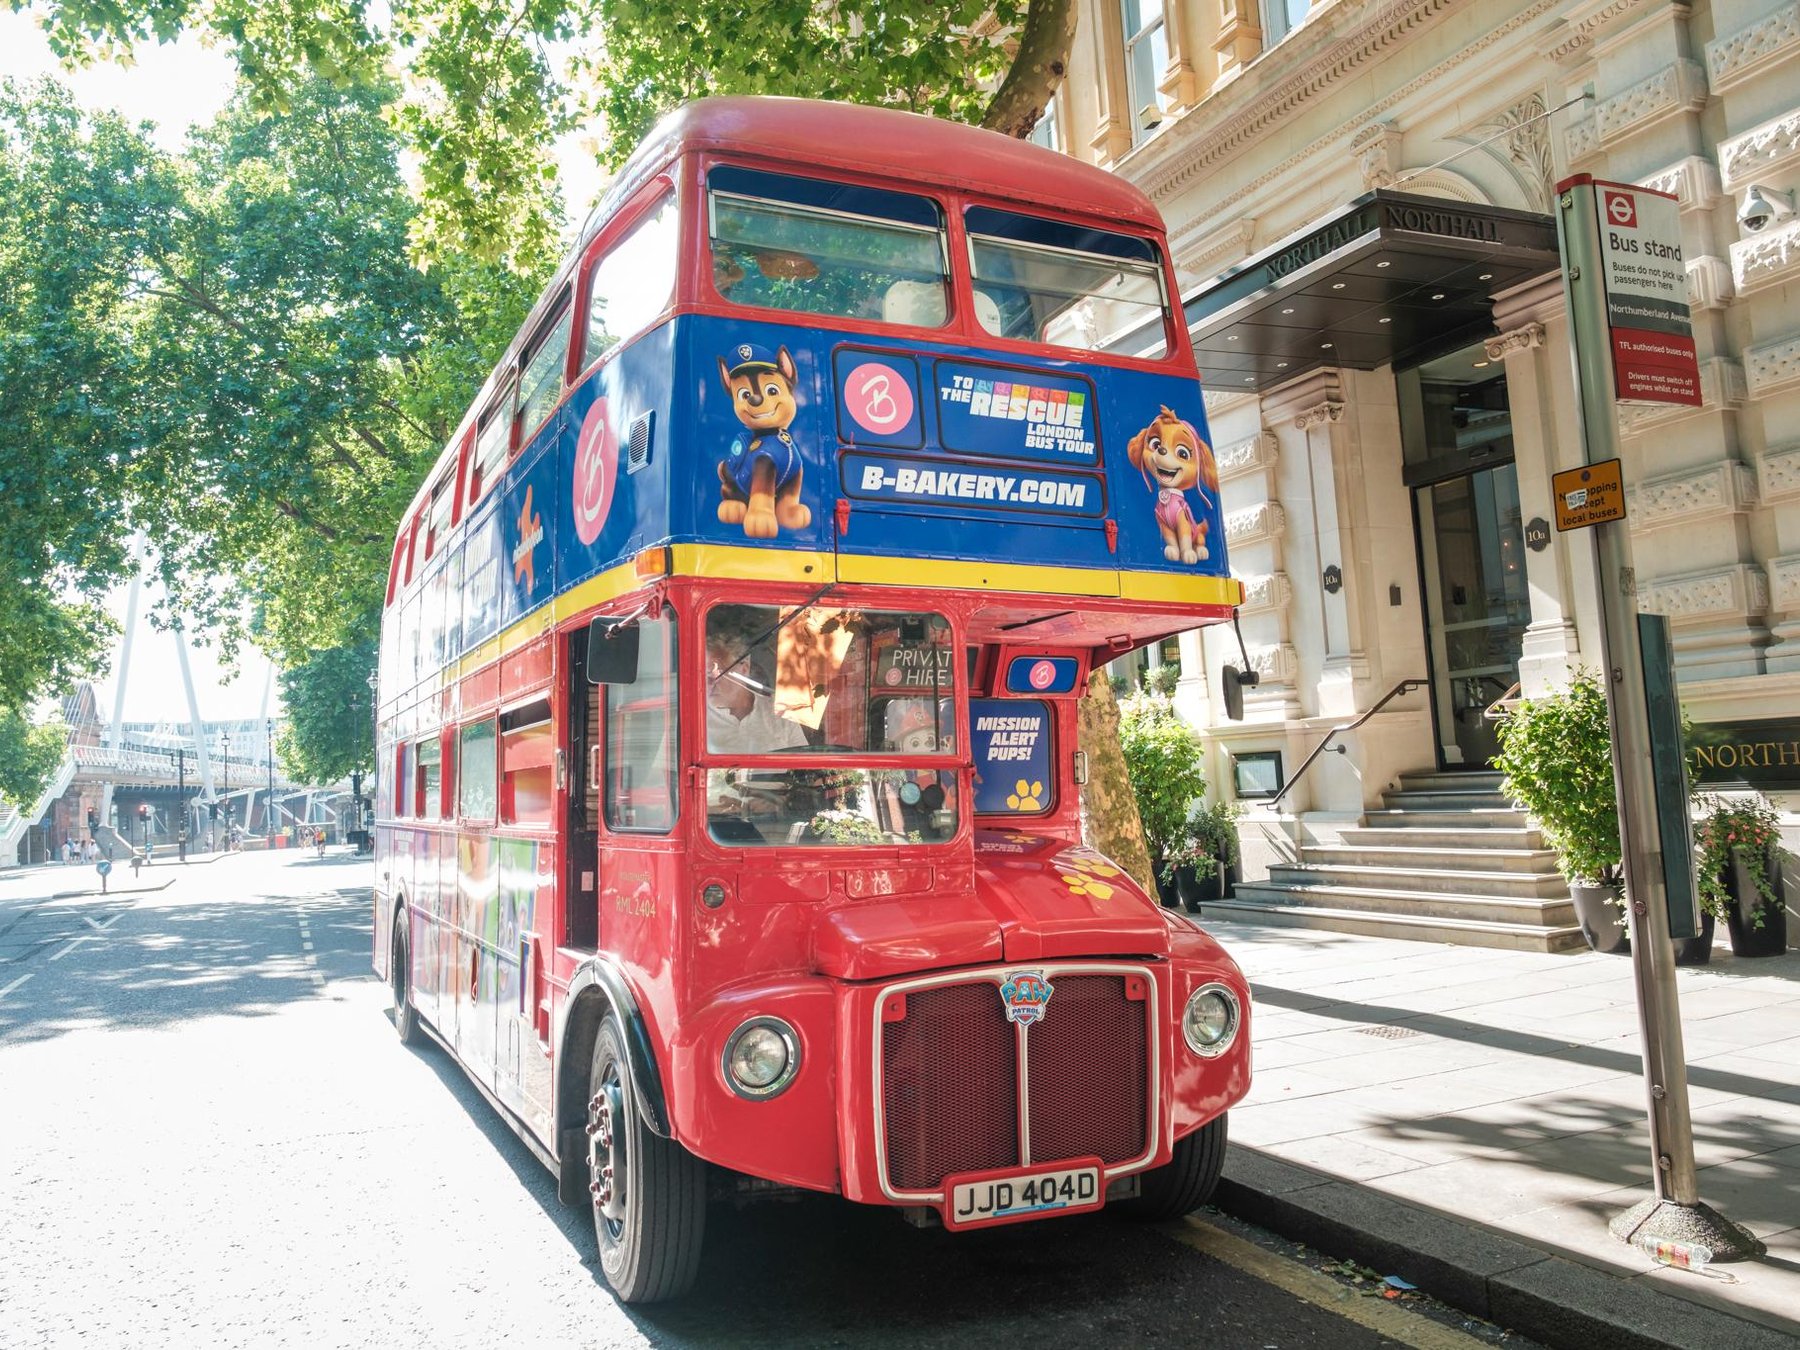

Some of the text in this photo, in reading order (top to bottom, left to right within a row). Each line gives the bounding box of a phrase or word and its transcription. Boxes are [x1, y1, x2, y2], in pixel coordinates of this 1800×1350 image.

[1386, 205, 1505, 242] NORTHALL
[1265, 214, 1370, 283] NORTHALL
[1609, 232, 1682, 261] Bus stand
[1612, 262, 1685, 283] Buses do not pick up
[1614, 275, 1674, 290] passengers here
[1610, 304, 1669, 320] Northumberland
[1619, 341, 1693, 360] TFL authorised buses only
[953, 375, 974, 389] TO
[1628, 371, 1650, 381] Drivers
[1651, 375, 1666, 383] must
[1666, 376, 1684, 386] switch
[861, 375, 897, 424] B
[941, 387, 971, 403] THE
[1629, 383, 1653, 392] engines
[1654, 384, 1671, 394] whilst
[1680, 387, 1694, 397] stand
[970, 388, 1085, 428] RESCUE
[1027, 422, 1085, 441] LONDON
[1025, 434, 1095, 455] BUS TOUR
[861, 466, 1086, 507] B-BAKERY.COM
[1563, 507, 1618, 526] local buses
[1528, 530, 1546, 542] 10a
[892, 650, 953, 667] PRIVAT
[906, 669, 948, 686] HIRE
[976, 717, 1041, 731] MISSION
[989, 732, 1039, 746] ALERT
[987, 747, 1033, 761] PUPS!
[1694, 742, 1800, 769] NORTH
[615, 896, 656, 918] RML 2404
[1000, 980, 1054, 1005] PAW
[1012, 1007, 1040, 1015] PATROL
[958, 1172, 1095, 1216] JJD 404D
